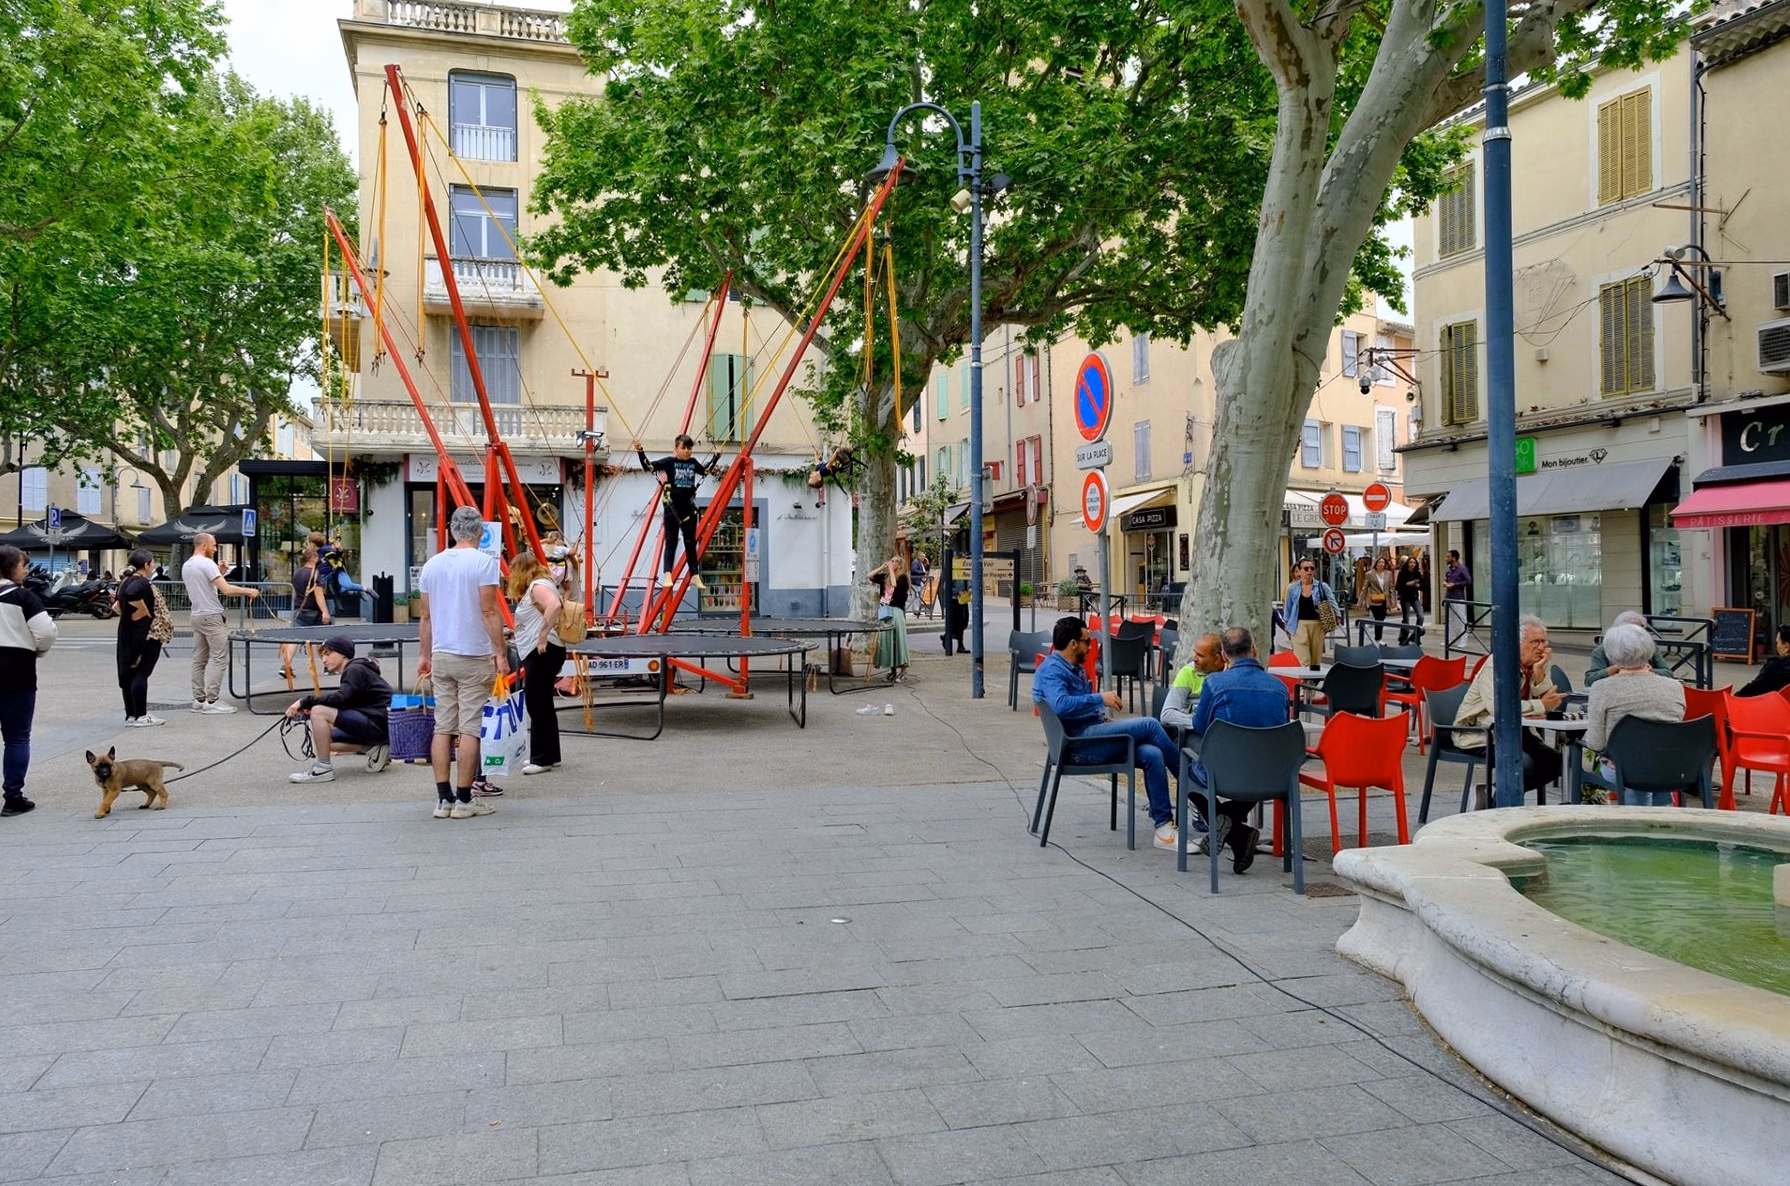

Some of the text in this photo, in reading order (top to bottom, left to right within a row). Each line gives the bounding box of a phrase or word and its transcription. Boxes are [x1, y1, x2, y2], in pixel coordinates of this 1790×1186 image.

[1077, 448, 1107, 462] SUR LA PLACE
[1541, 460, 1558, 468] Mon
[1298, 504, 1314, 512] PIZZA
[1323, 505, 1347, 515] STOP
[1132, 514, 1162, 525] CASA PIZZA
[1292, 513, 1301, 523] LE
[1689, 512, 1764, 527] PÂTISSERIE
[599, 661, 612, 669] 961
[614, 660, 624, 669] ER
